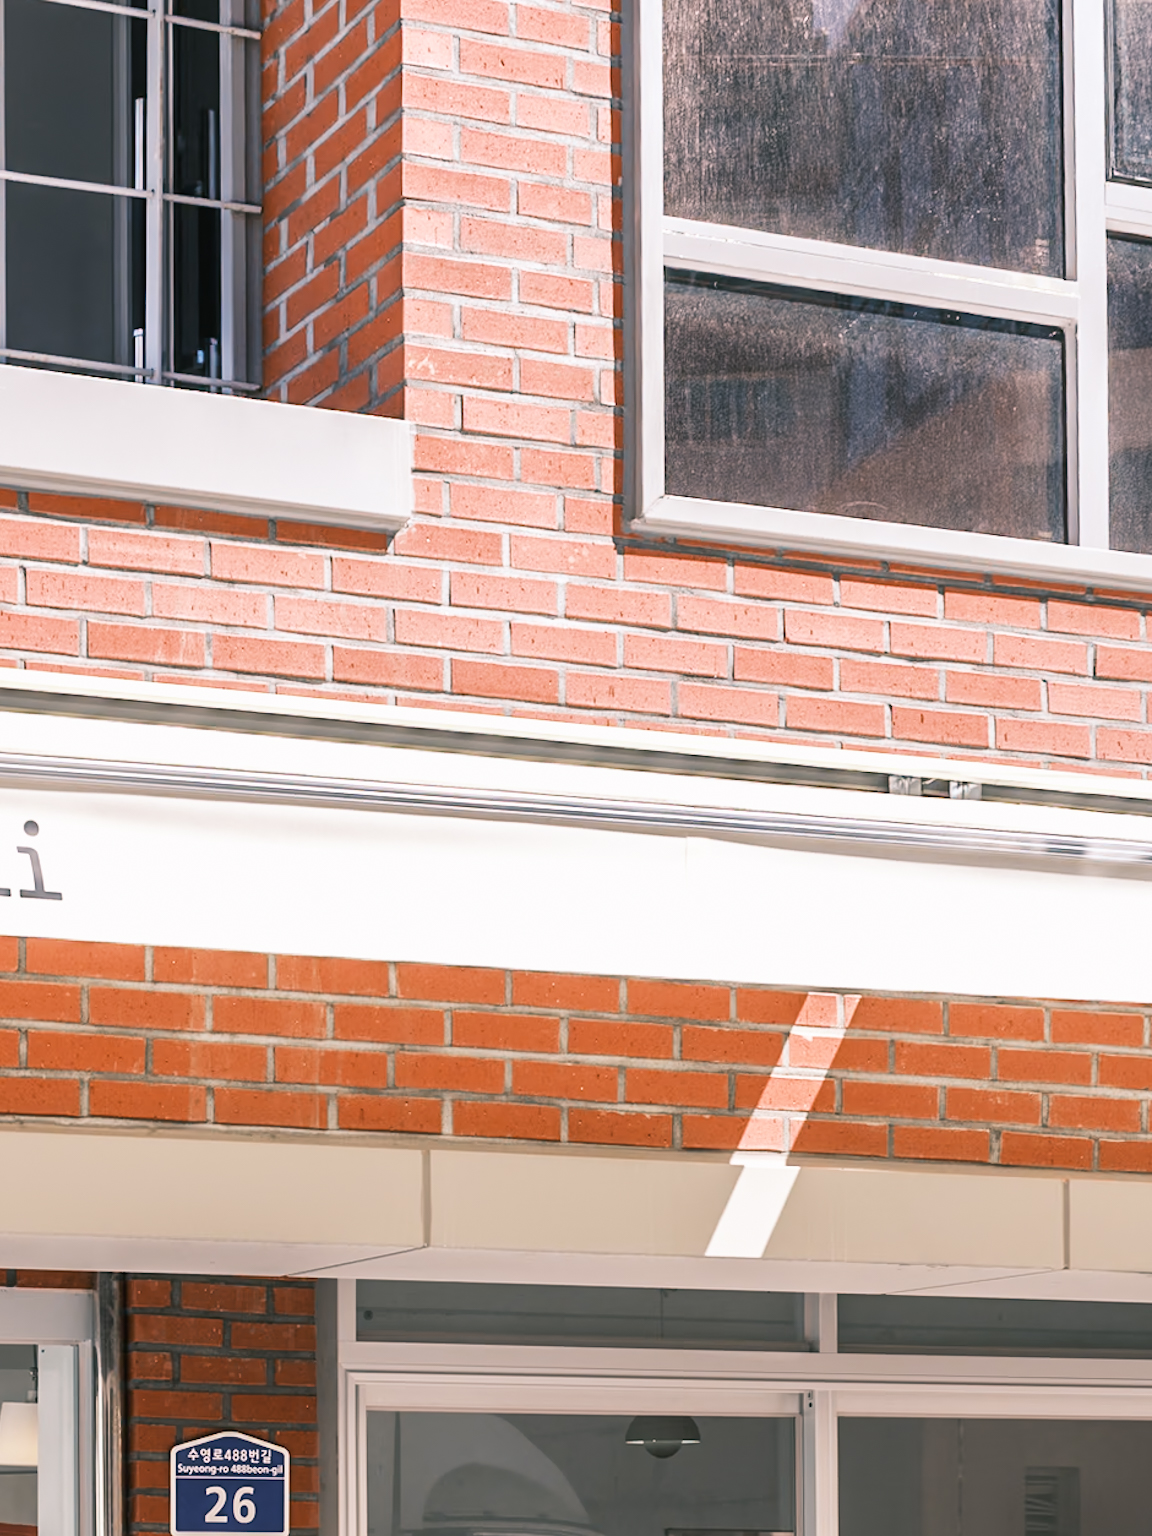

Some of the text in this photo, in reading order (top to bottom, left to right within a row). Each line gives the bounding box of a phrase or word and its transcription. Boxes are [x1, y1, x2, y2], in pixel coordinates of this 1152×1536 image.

[187, 1448, 272, 1464] 수영로488번길
[177, 1463, 283, 1476] Suyeong-ro 488beon-gil
[204, 1485, 256, 1524] 26
